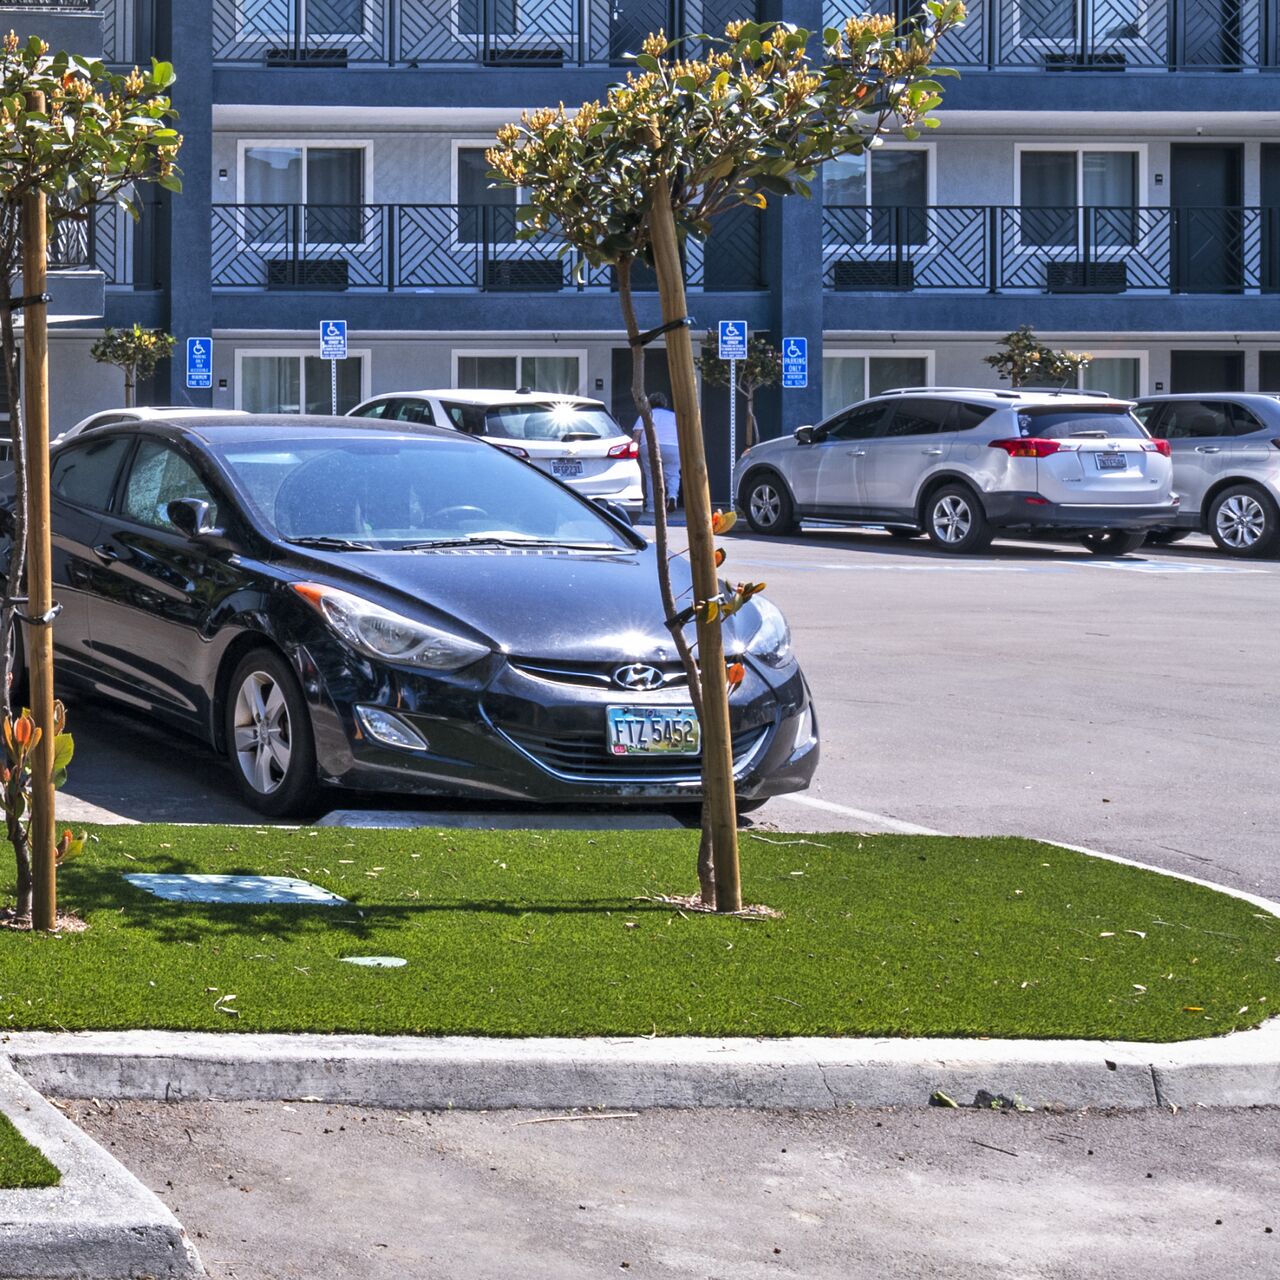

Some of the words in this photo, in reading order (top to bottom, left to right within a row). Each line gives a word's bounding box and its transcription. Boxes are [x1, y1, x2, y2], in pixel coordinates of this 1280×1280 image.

[785, 357, 806, 365] PARKING
[788, 365, 802, 373] ONLY
[614, 718, 648, 743] FTZ
[651, 718, 695, 744] 5452
